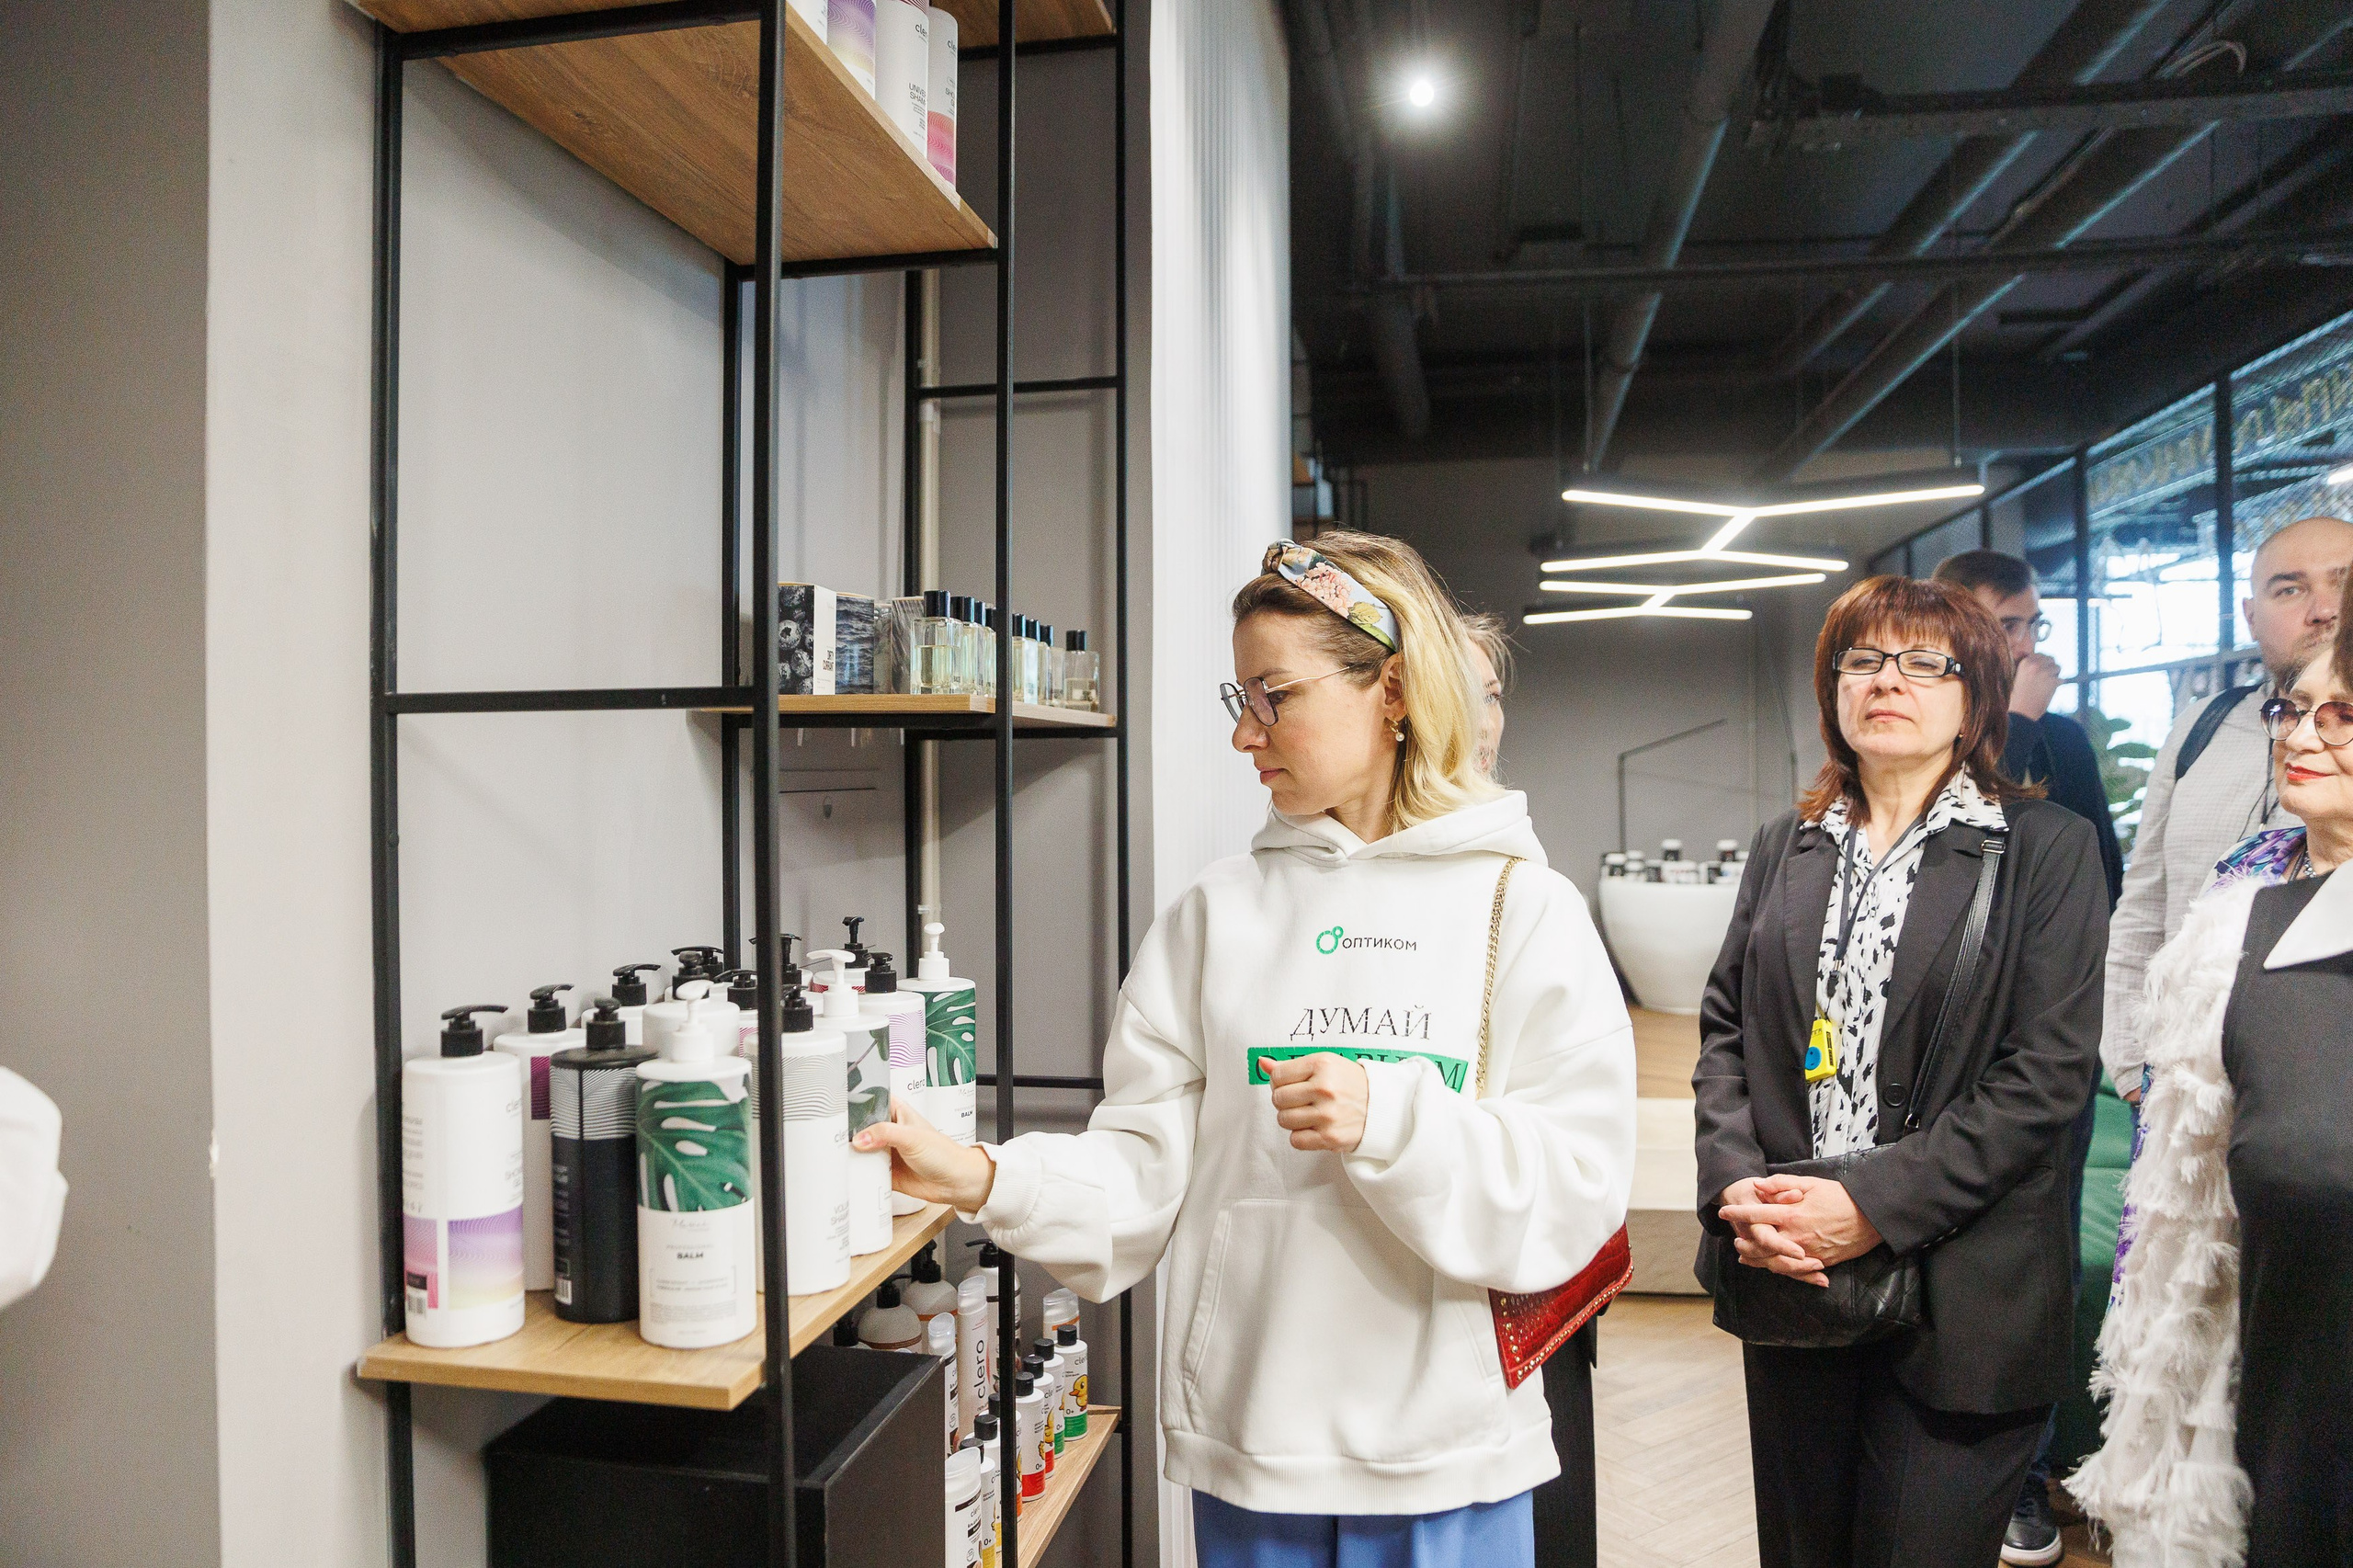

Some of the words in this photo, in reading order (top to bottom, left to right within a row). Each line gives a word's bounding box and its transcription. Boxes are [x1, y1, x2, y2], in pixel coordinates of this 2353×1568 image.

[1342, 937, 1417, 951] ОПТИКОМ
[1290, 1005, 1432, 1041] ДУМАЙ
[676, 1252, 704, 1260] BALM
[974, 1339, 985, 1399] clero
